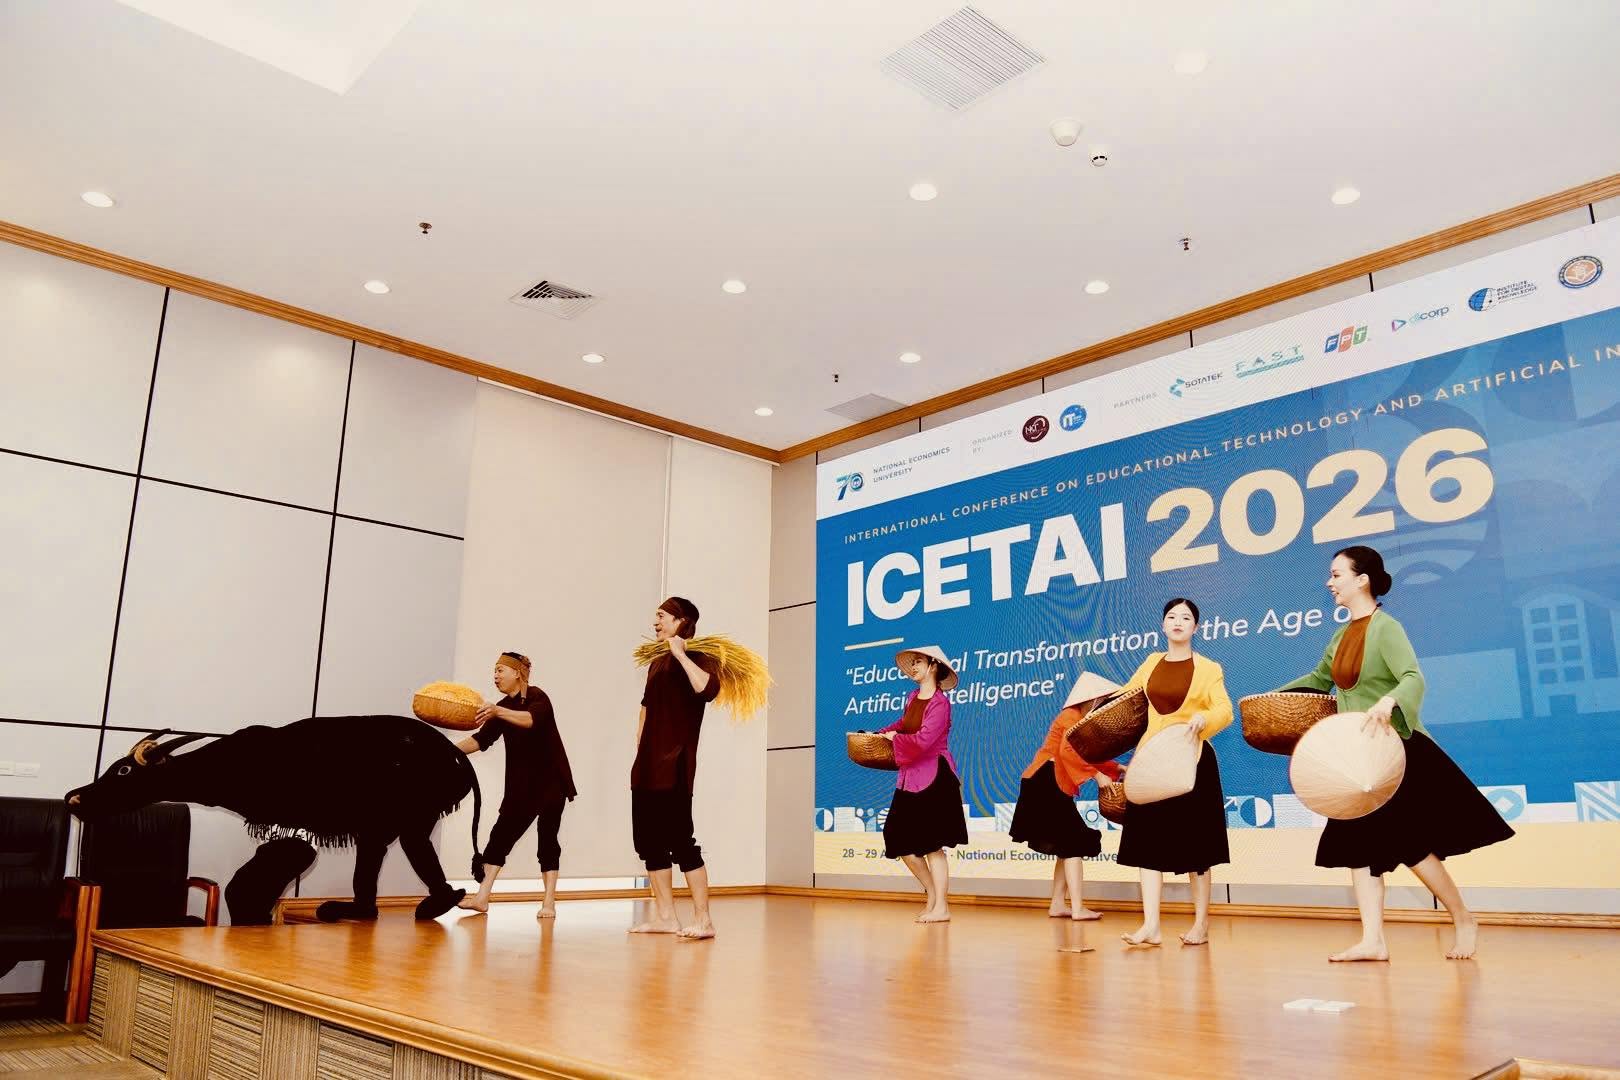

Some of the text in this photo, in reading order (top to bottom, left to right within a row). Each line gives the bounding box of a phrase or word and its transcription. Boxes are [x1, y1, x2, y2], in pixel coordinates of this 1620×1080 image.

[1325, 328, 1368, 351] FPT
[1234, 344, 1302, 372] FAST
[1185, 371, 1224, 388] SOTATEK
[844, 512, 946, 545] INTERNATIONAL
[952, 485, 1049, 518] CONFERENCE
[1056, 478, 1078, 493] ON
[1086, 446, 1213, 486] EDUCATIONAL
[1222, 408, 1362, 452] TECHNOLOGY
[1374, 394, 1422, 416] AND
[1435, 355, 1581, 401] ARTIFICIAL
[873, 446, 951, 474] NATIONAL ECONOMICS
[836, 471, 864, 501] 70
[873, 466, 913, 483] UNIVERSITY
[847, 427, 1494, 627] ICETAI 2026
[846, 606, 1353, 686] “Educaal Transformation the Age o
[844, 673, 1065, 716] Artifici telligence”
[842, 848, 855, 858] 28
[865, 848, 878, 859] 29
[956, 849, 1007, 861] National
[1010, 850, 1055, 861] Econo
